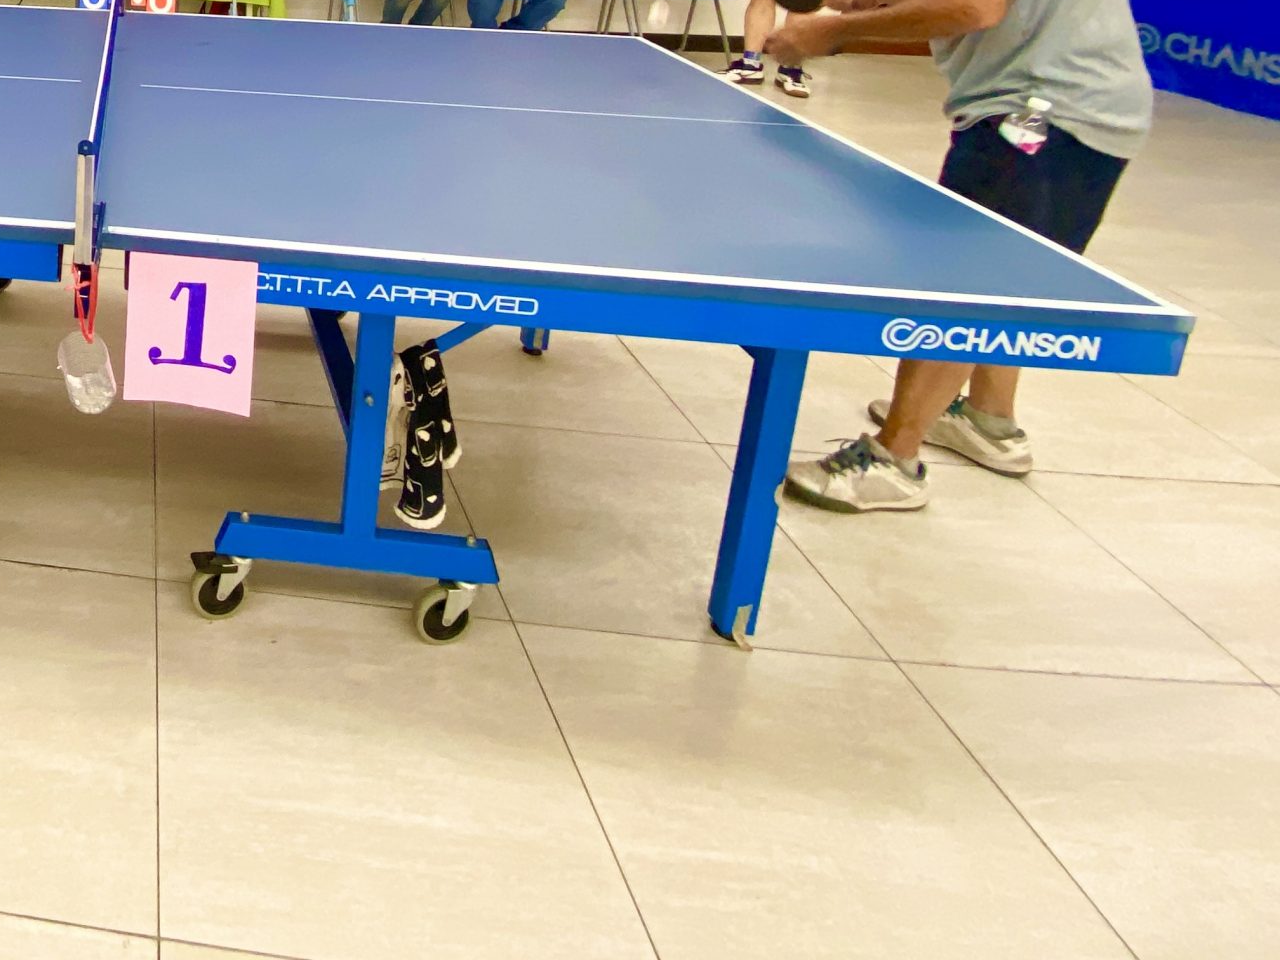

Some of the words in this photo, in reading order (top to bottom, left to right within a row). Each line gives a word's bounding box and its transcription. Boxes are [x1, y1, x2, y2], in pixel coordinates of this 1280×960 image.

[367, 284, 539, 316] APPROVED
[148, 281, 237, 375] 1
[943, 326, 1102, 362] CHANSON
